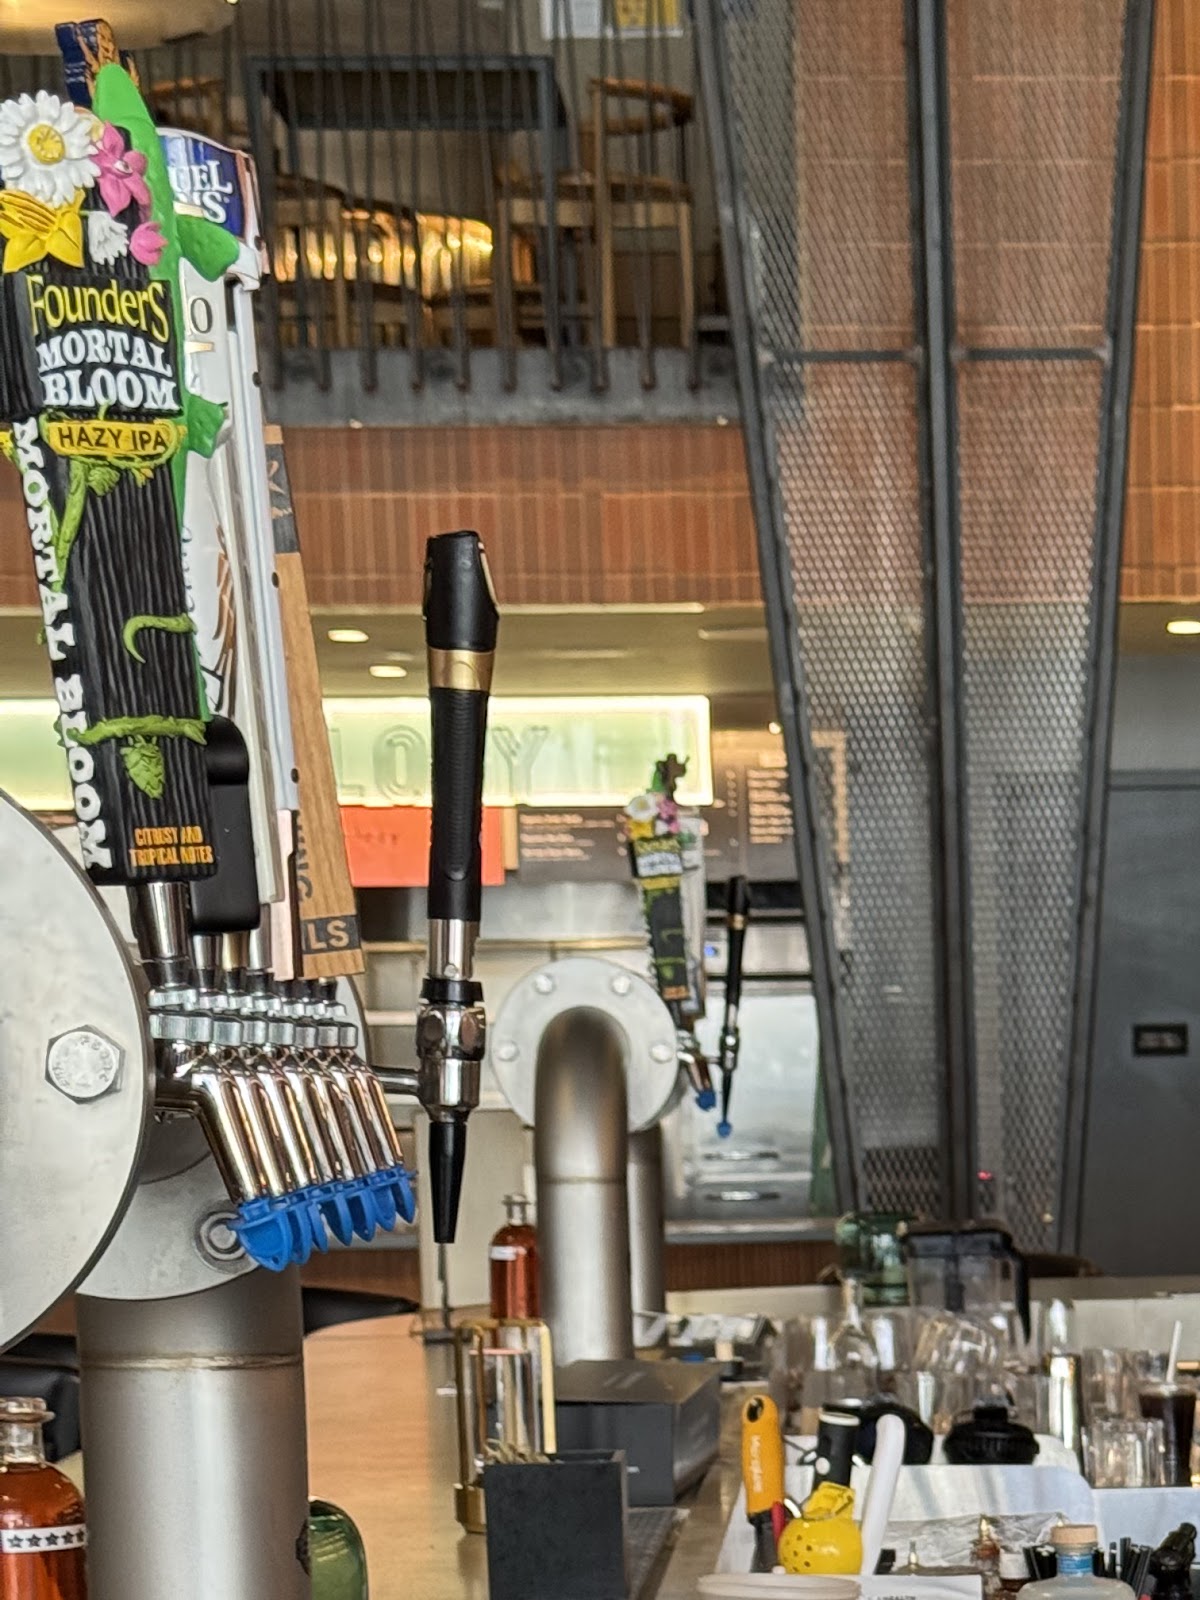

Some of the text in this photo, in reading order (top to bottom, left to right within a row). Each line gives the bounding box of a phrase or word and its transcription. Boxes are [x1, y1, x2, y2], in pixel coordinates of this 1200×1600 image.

[36, 328, 173, 377] MORTAL
[41, 368, 181, 410] BLOOM
[58, 427, 168, 450] HAZY IPA
[13, 417, 76, 661] MORTAL
[134, 826, 203, 846] CITRUSY AND
[129, 845, 213, 867] TROPICAL NOTES
